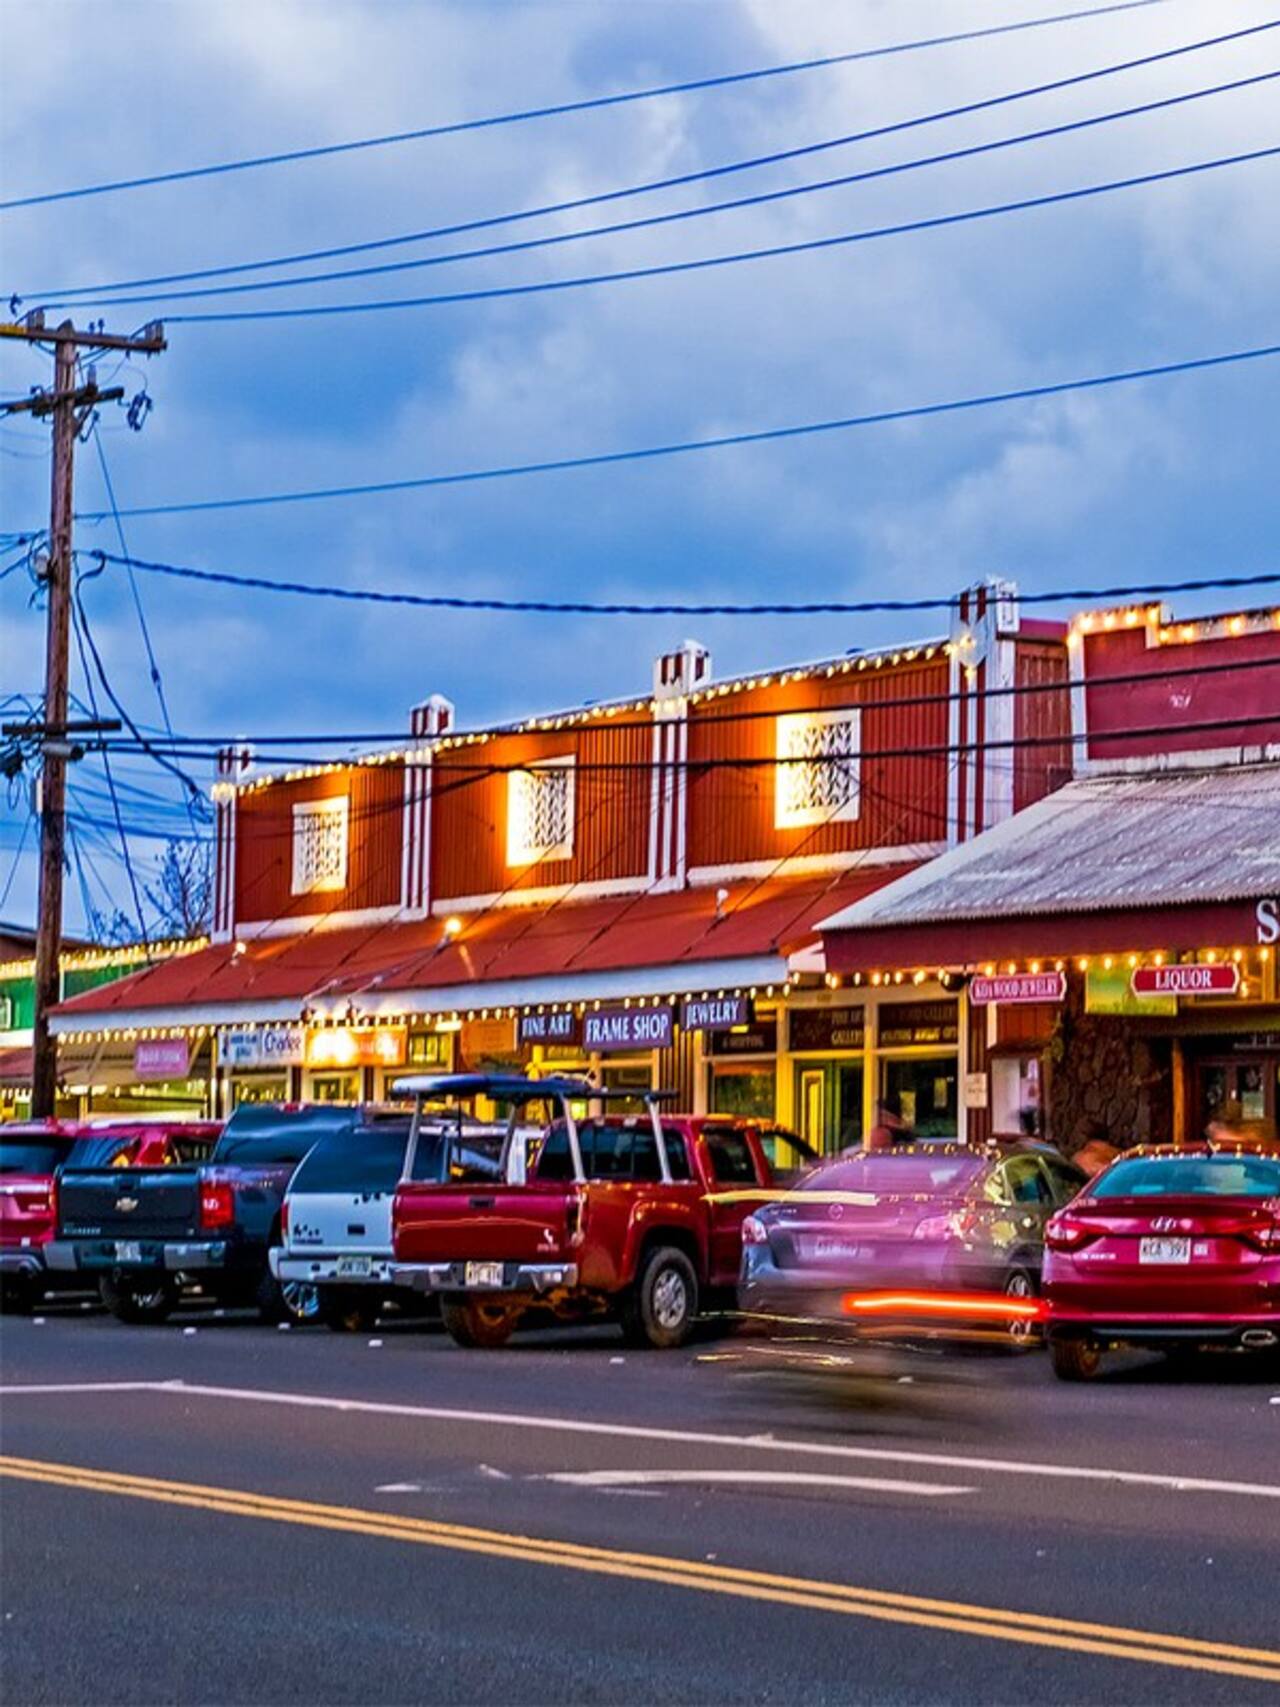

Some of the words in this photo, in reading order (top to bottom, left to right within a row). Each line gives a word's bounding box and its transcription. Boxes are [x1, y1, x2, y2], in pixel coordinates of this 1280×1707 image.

[994, 980, 1020, 998] WOOD
[1019, 977, 1058, 997] JEWELRY
[1154, 970, 1213, 992] LIQUOR
[522, 1016, 546, 1037] FINE
[550, 1013, 572, 1035] ART
[685, 999, 740, 1029] JEWELRY
[585, 1017, 629, 1043] FRAME
[633, 1013, 669, 1040] SHOP
